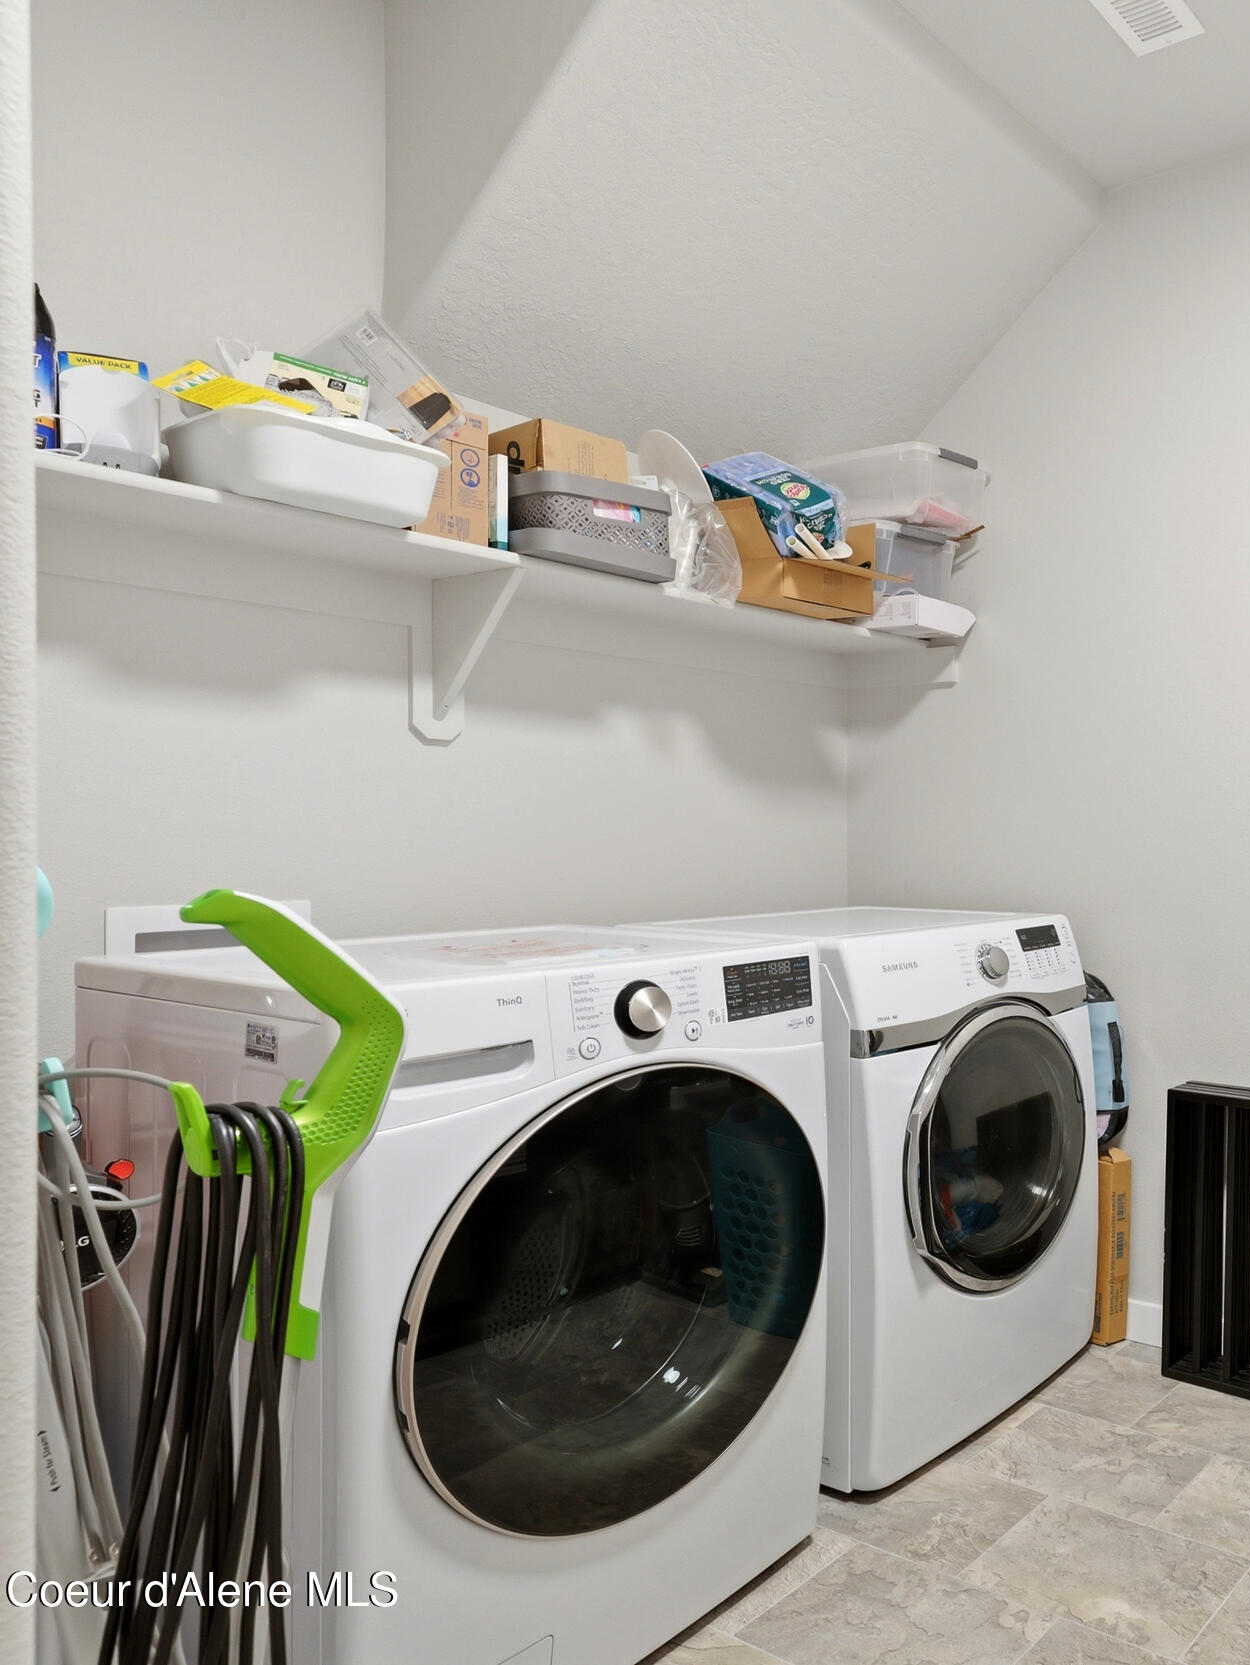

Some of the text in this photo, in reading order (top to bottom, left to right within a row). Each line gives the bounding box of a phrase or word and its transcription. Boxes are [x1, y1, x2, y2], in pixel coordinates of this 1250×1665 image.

[75, 356, 132, 371] VALUE PACK
[882, 961, 919, 973] SAMSUNG
[496, 996, 523, 1007] ThinQ
